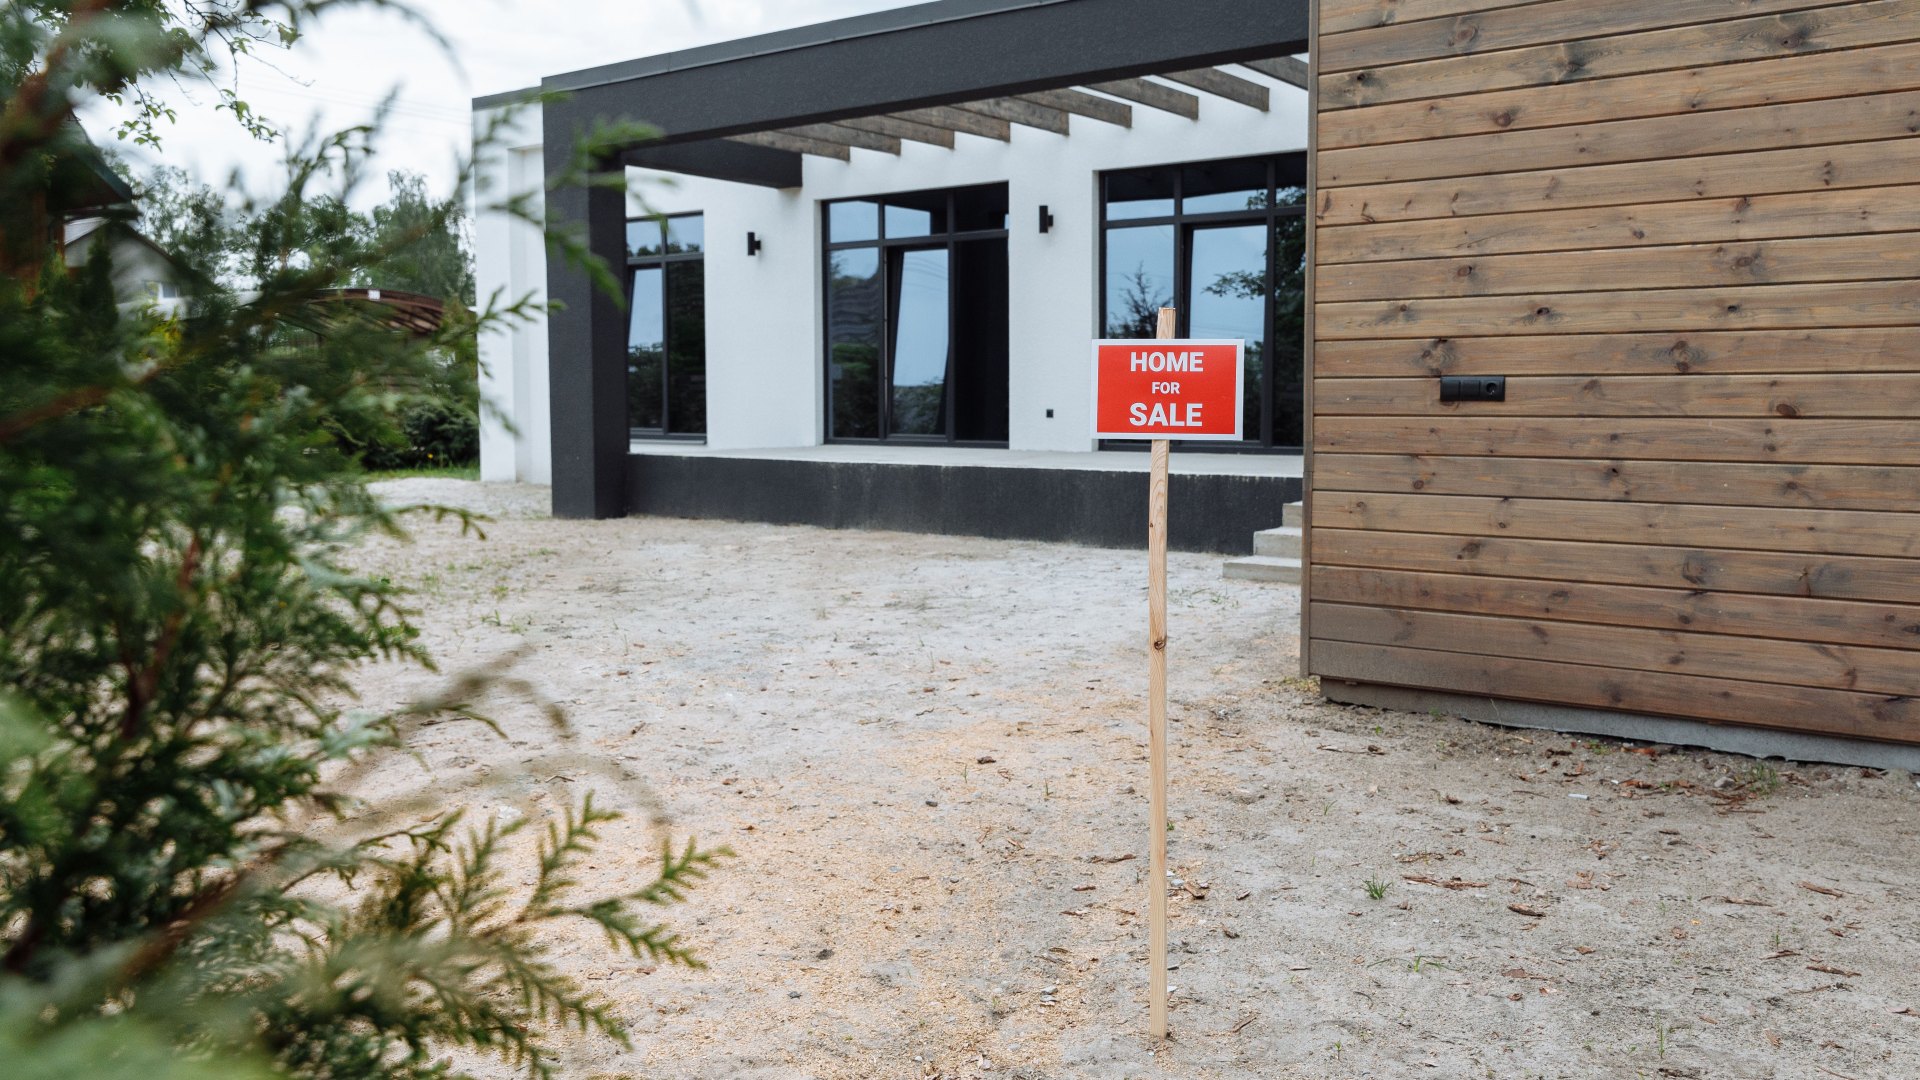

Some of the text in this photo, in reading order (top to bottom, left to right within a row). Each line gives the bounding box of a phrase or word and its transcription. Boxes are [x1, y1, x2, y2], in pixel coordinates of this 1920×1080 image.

[1130, 351, 1204, 372] HOME
[1151, 381, 1180, 394] FOR
[1129, 402, 1203, 427] SALE
